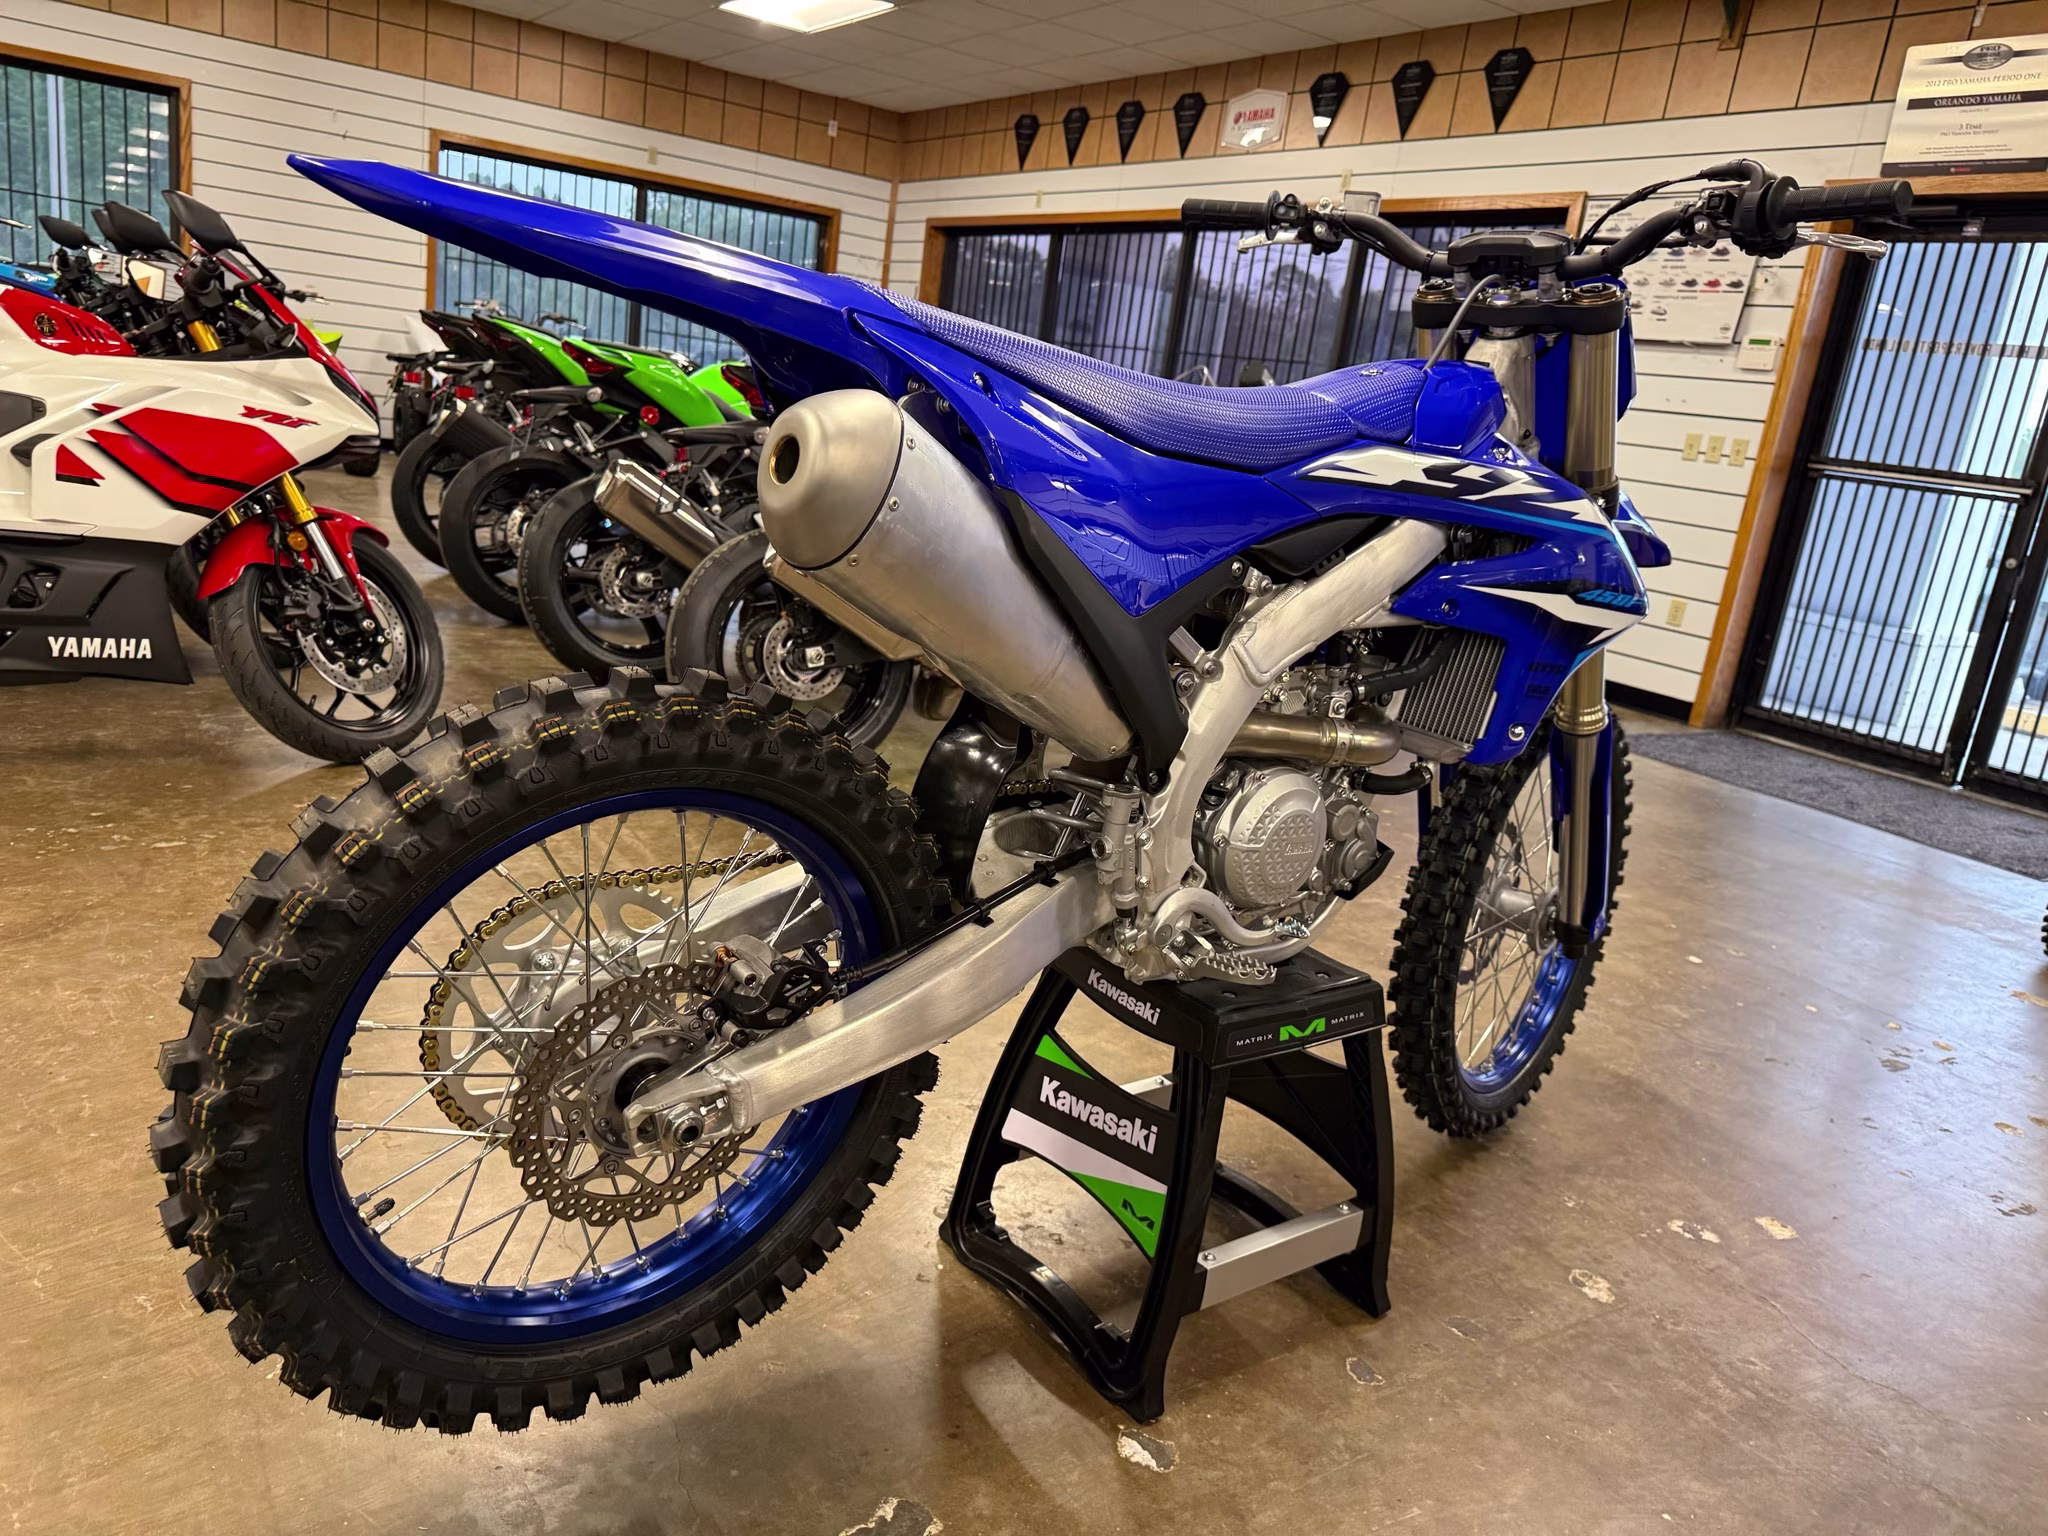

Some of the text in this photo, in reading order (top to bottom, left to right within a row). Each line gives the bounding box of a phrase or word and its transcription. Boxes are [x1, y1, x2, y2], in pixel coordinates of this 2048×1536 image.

[1925, 72, 2042, 88] 2012 PRO YAMAHA PERIOD ONE
[1934, 93, 2022, 107] ORLANDO YAMAHA
[1242, 107, 1275, 124] YAMAHA
[48, 636, 152, 660] YAMAHA
[1087, 967, 1161, 1026] Kawasaki
[1236, 1033, 1273, 1047] MATRIX
[1331, 1011, 1365, 1025] MATRIX
[1040, 1075, 1159, 1155] Kawasaki
